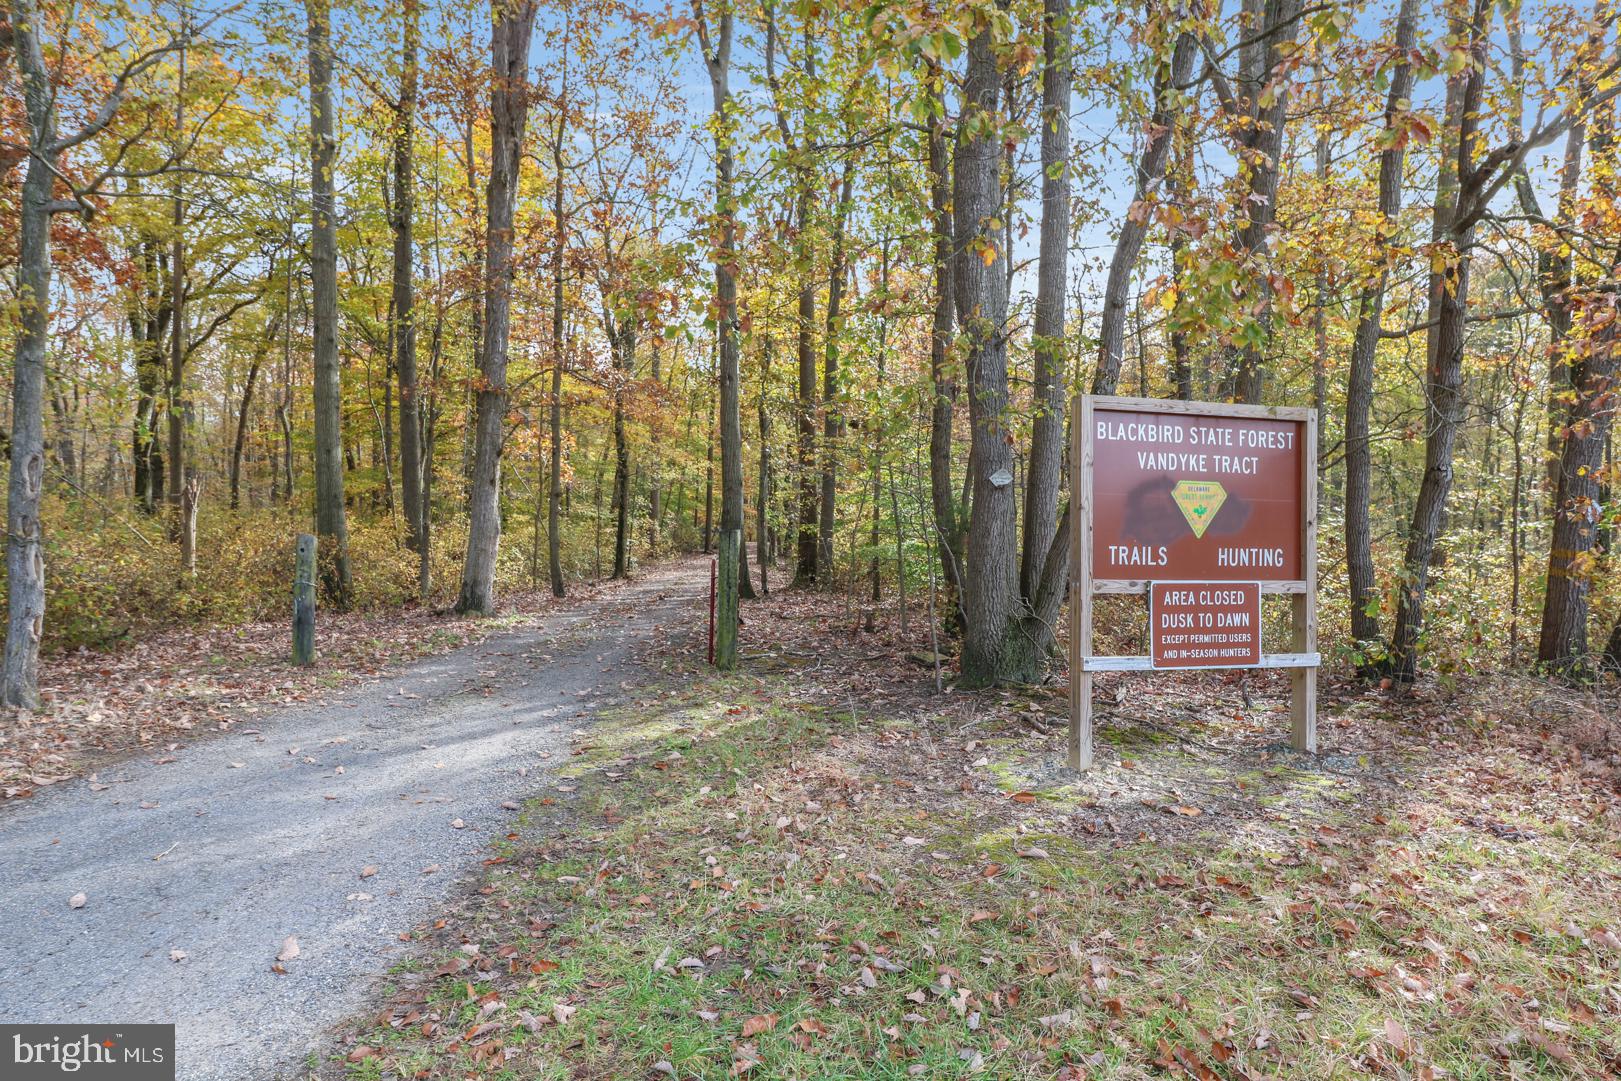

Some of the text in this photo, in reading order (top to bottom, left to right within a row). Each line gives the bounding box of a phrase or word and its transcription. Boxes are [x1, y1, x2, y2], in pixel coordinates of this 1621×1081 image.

[1097, 422, 1294, 449] BLACKBIRD STATE FOREST
[1137, 451, 1258, 474] VANDYKE TRACT
[1109, 546, 1168, 566] TRAILS
[1218, 548, 1283, 567] HUNTING
[1164, 591, 1245, 606] AREA CLOSED
[1161, 612, 1250, 628] DUSK TO DAWN
[1162, 633, 1251, 644] EXCEPT PERMITTED USERS
[1163, 648, 1251, 659] AND IN-SEASON HUNTERS
